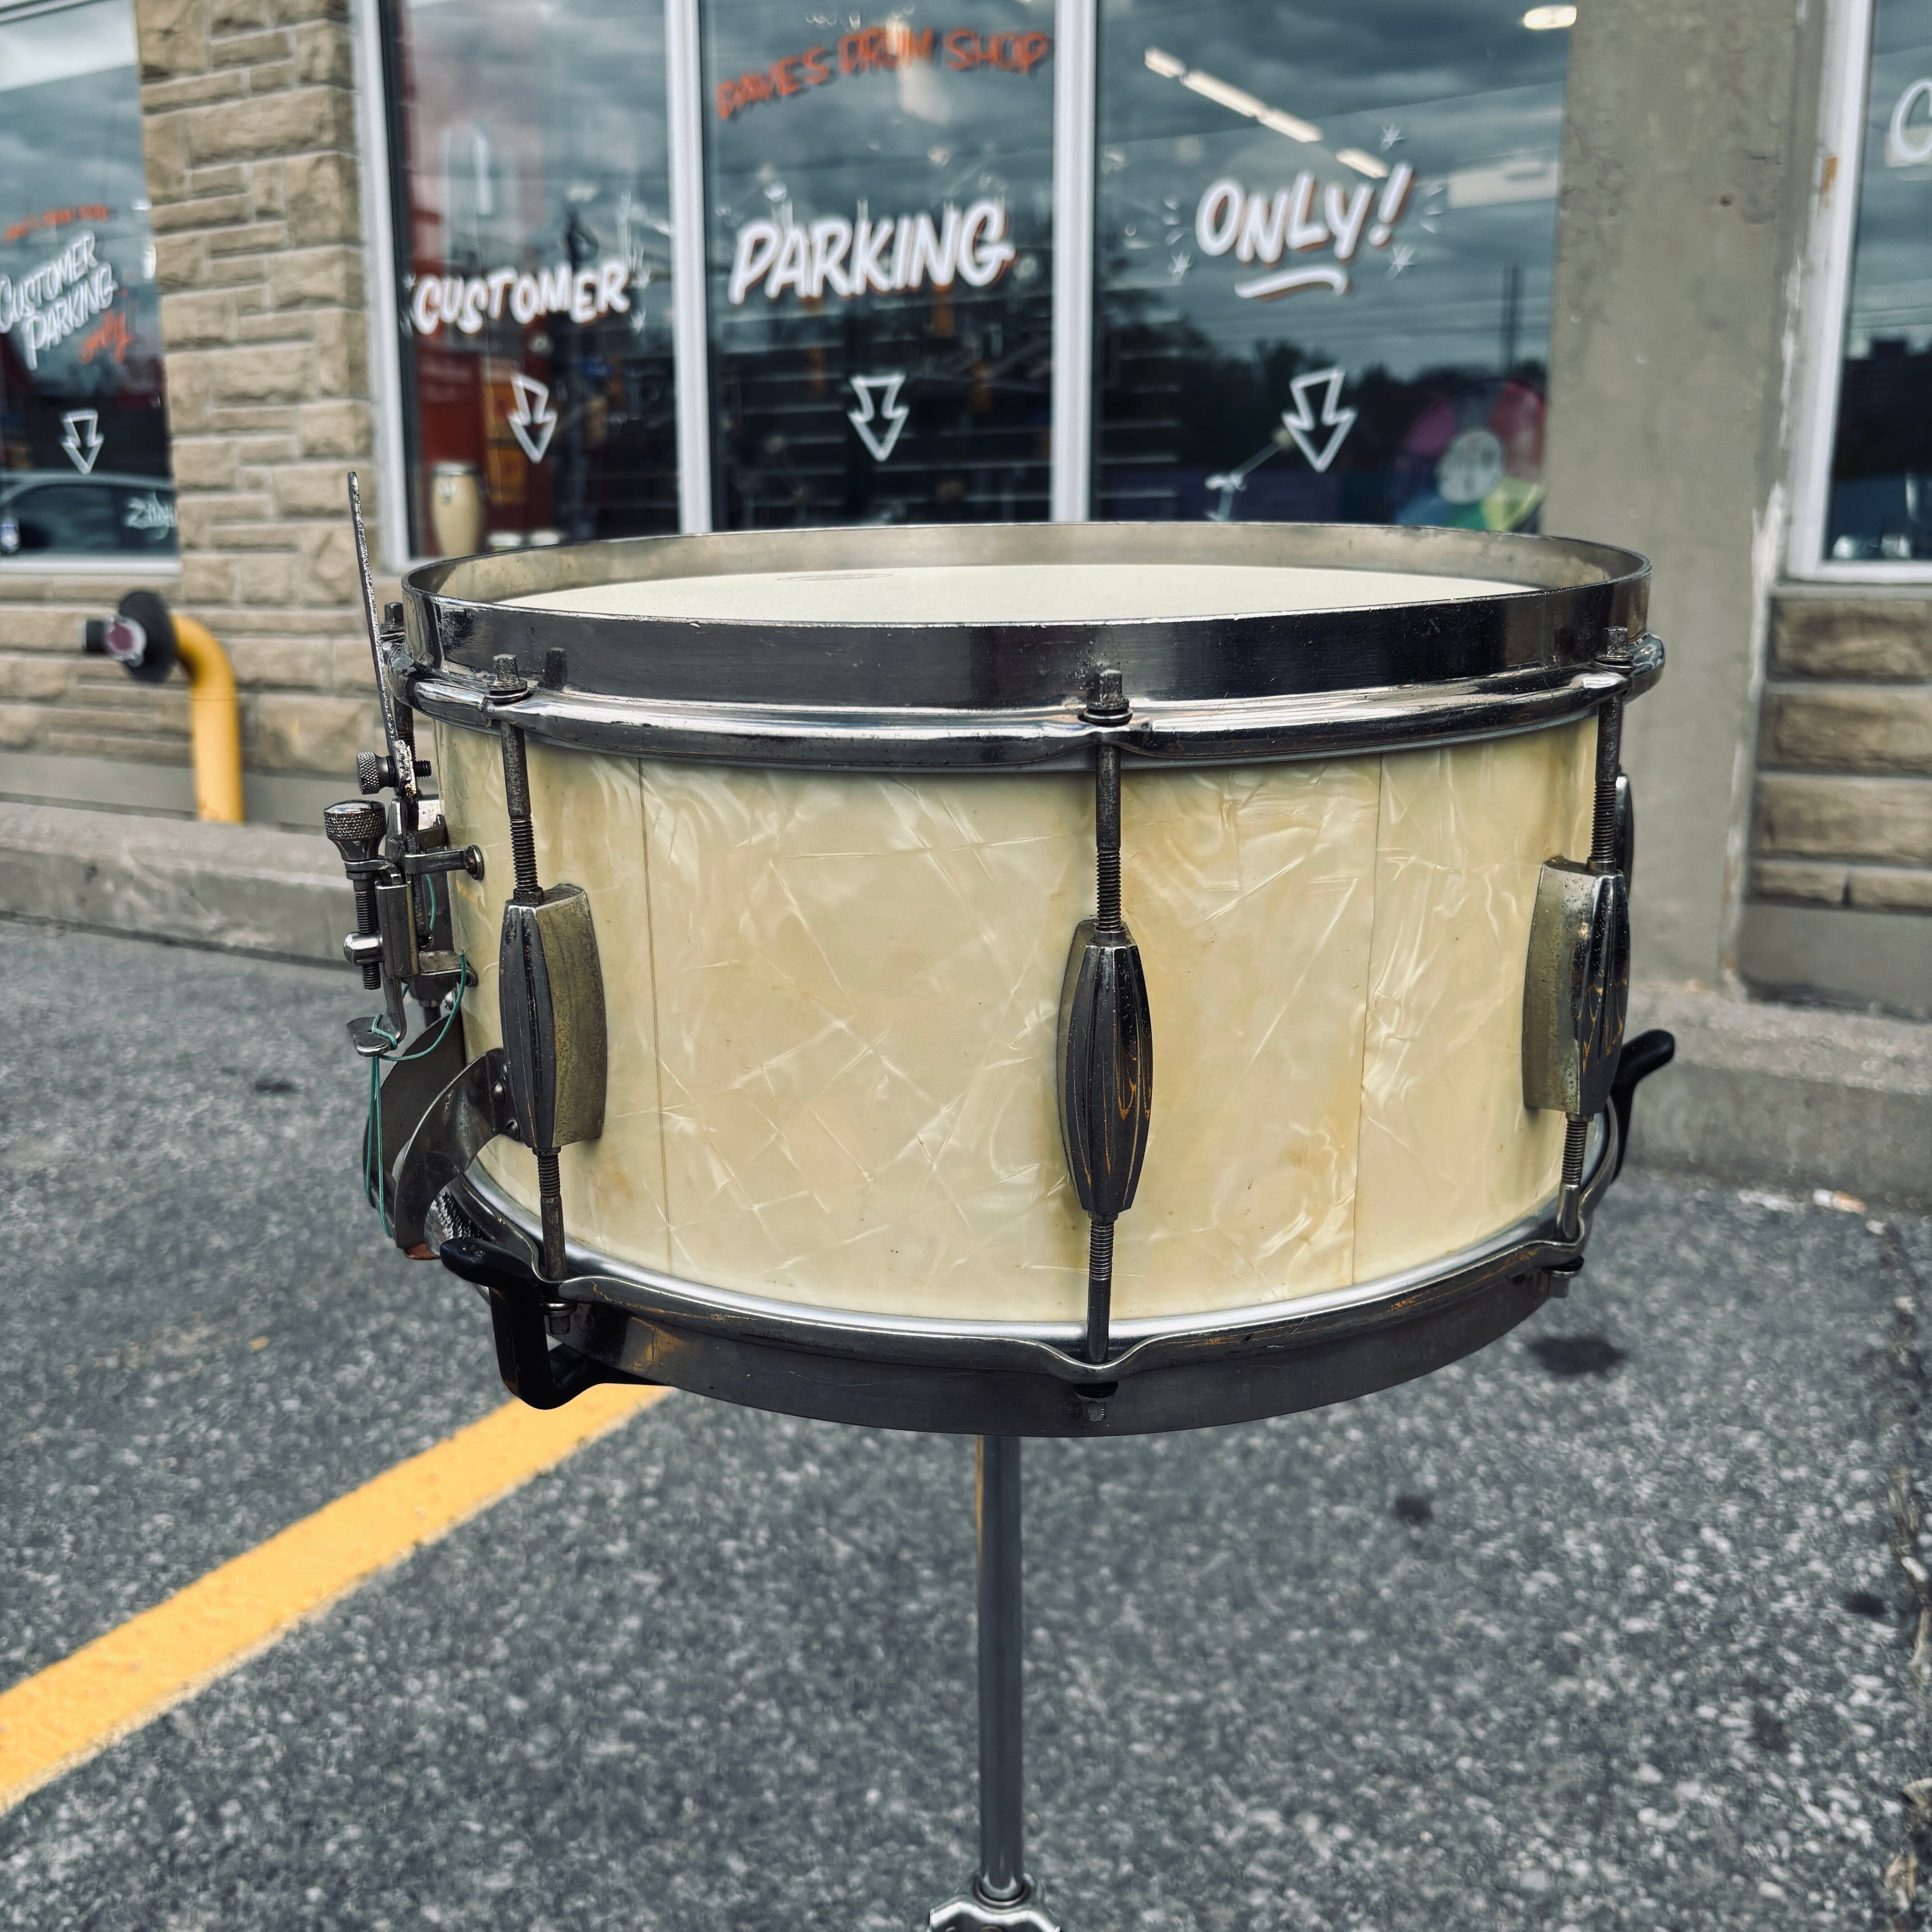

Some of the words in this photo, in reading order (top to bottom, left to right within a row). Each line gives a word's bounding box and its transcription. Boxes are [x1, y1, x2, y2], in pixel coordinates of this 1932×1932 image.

[944, 27, 1050, 75] SHOP
[0, 229, 98, 334] CUSTOMER
[412, 260, 631, 336] CUSTOMER
[727, 200, 1017, 306] PARKING
[1195, 161, 1415, 265] ONLY!
[22, 261, 119, 371] PARKING
